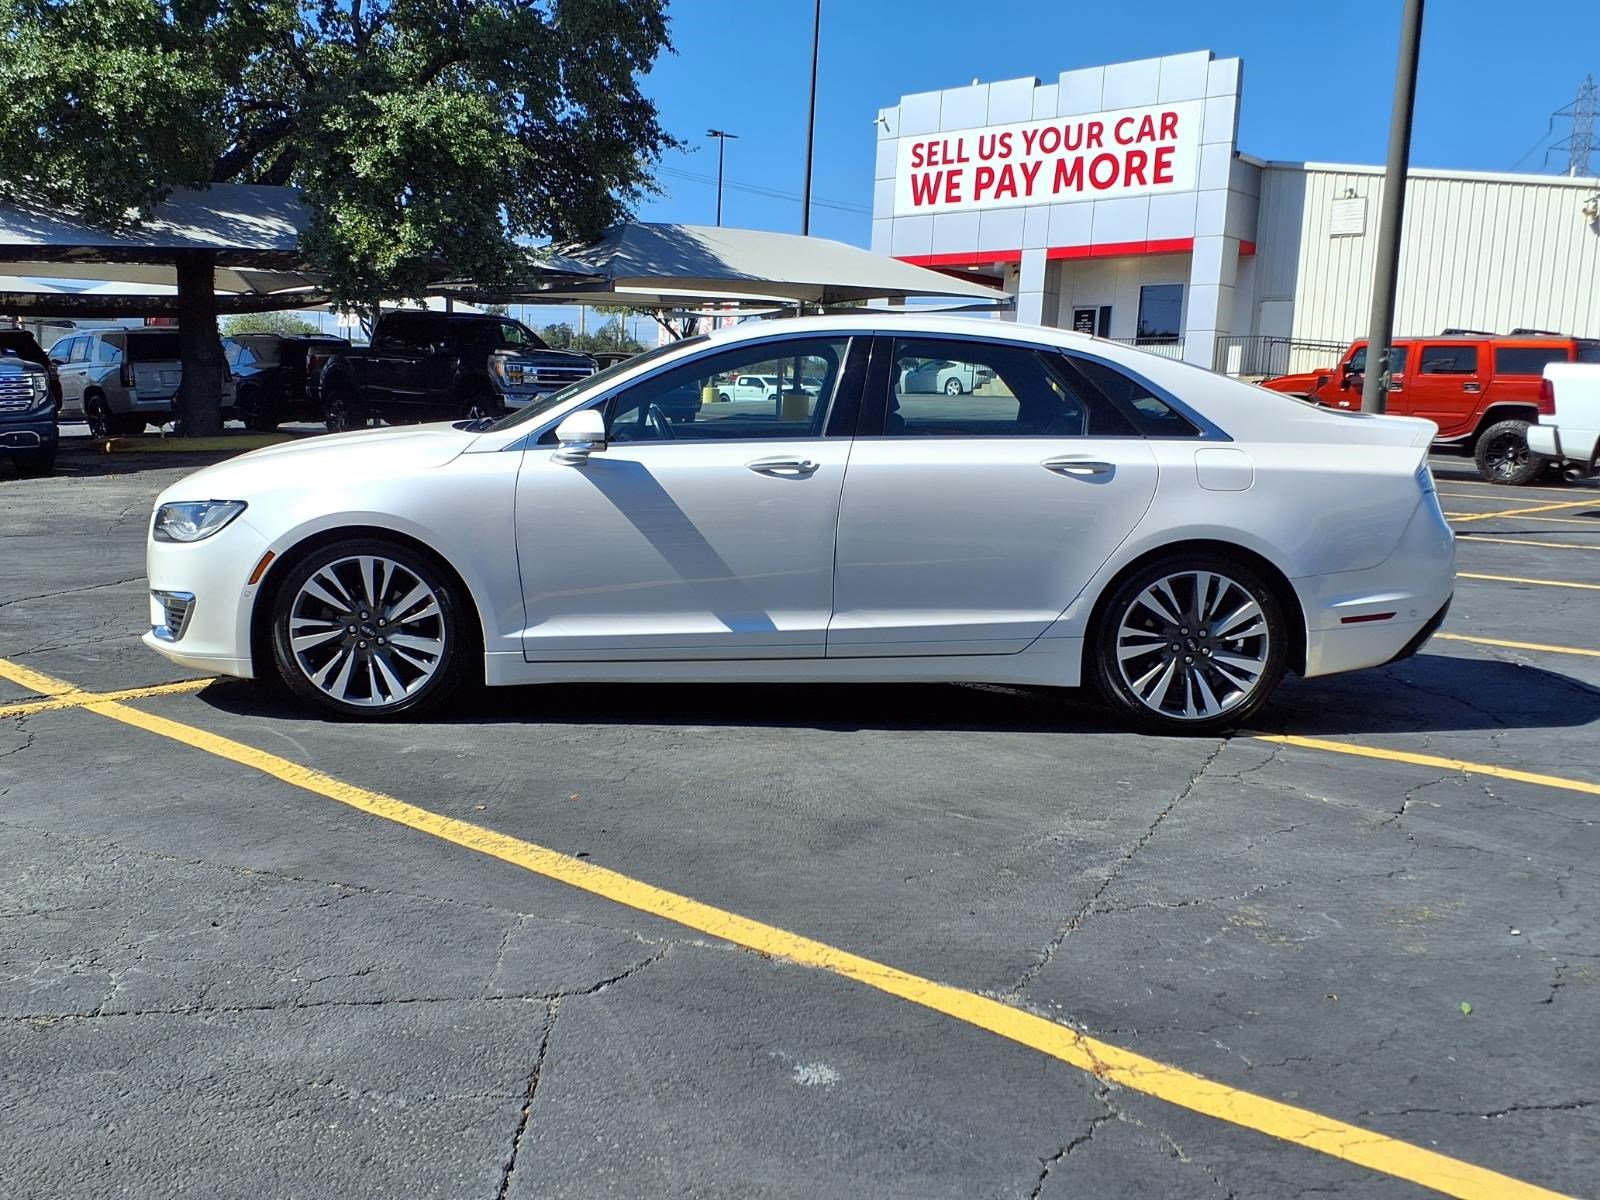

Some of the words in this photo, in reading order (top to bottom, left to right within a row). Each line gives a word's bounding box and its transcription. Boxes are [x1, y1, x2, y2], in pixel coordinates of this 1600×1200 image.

[912, 141, 969, 168] SELL
[979, 132, 1012, 161] US
[1023, 121, 1105, 156] YOUR
[1113, 111, 1178, 145] CAR
[911, 169, 963, 206] WE
[974, 161, 1042, 201] PAY
[1053, 146, 1176, 193] MORE
